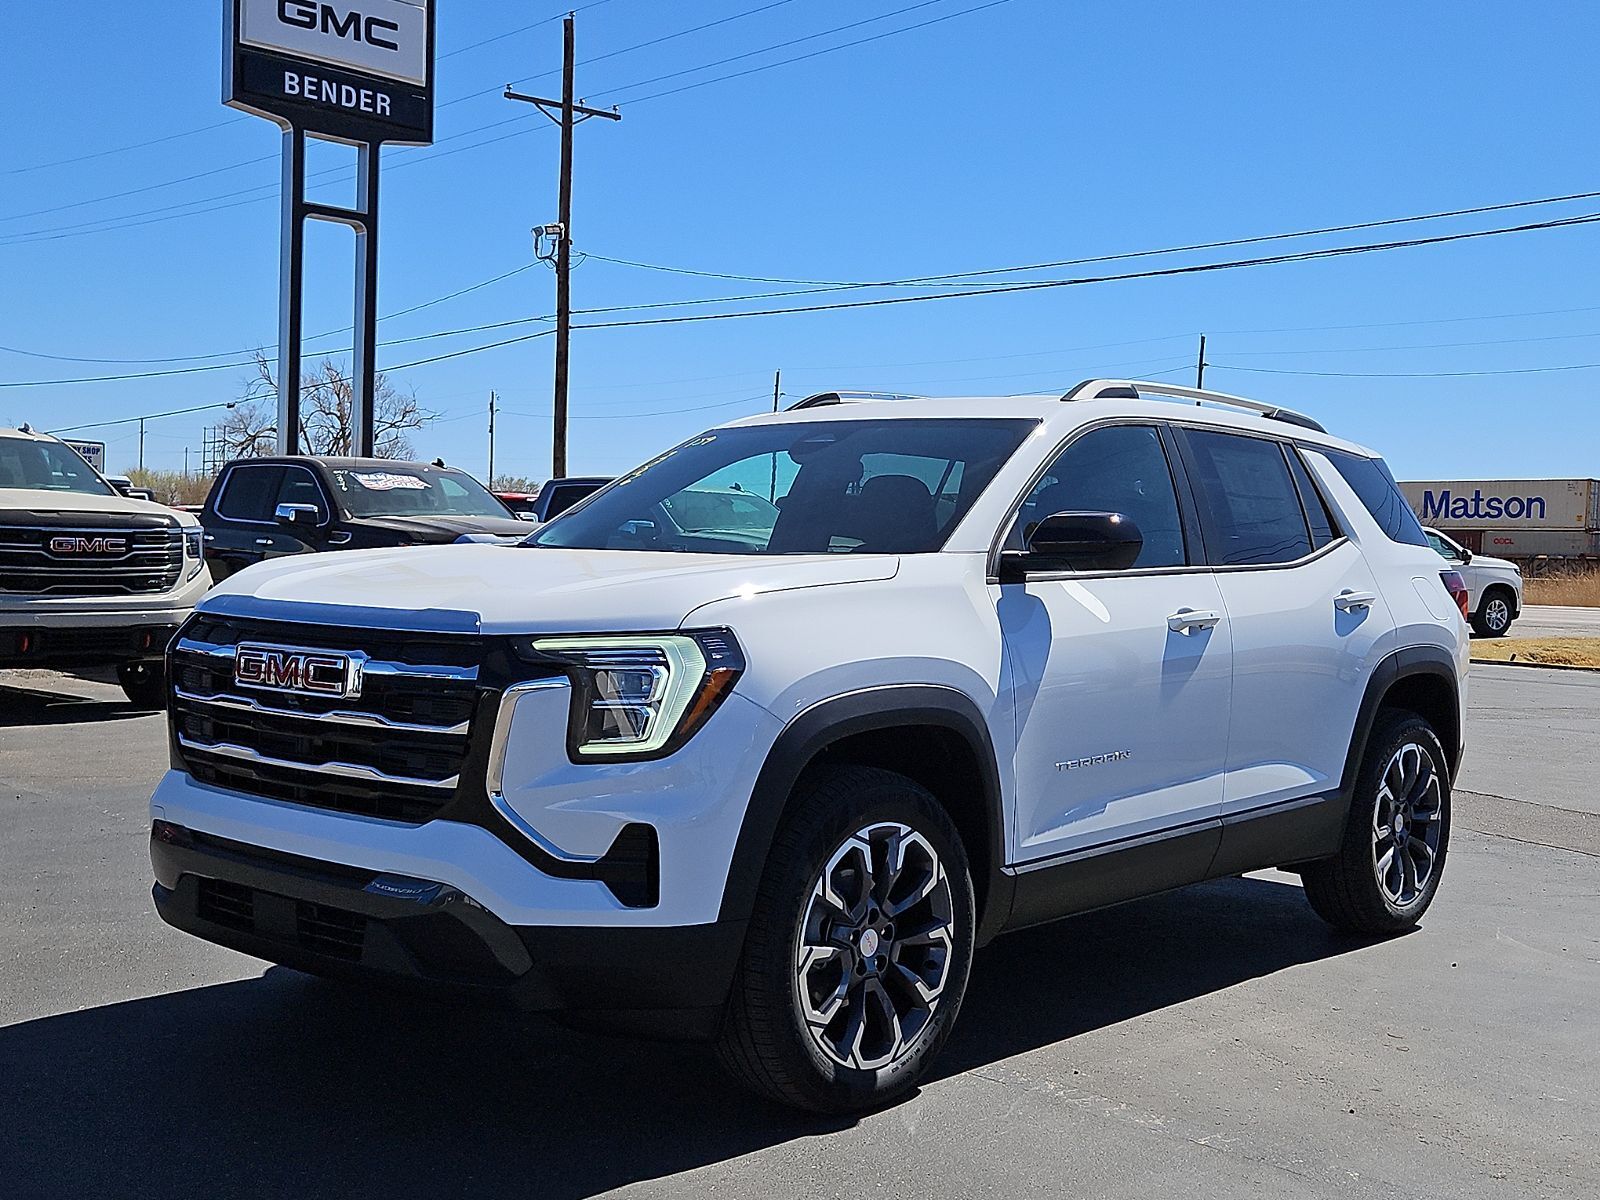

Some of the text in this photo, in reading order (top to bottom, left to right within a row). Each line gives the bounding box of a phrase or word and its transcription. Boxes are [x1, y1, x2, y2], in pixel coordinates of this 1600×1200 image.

[277, 0, 399, 51] GMC
[284, 71, 391, 116] BENDER
[1422, 489, 1546, 519] Matson
[50, 537, 126, 552] GMC
[236, 650, 344, 692] GMC
